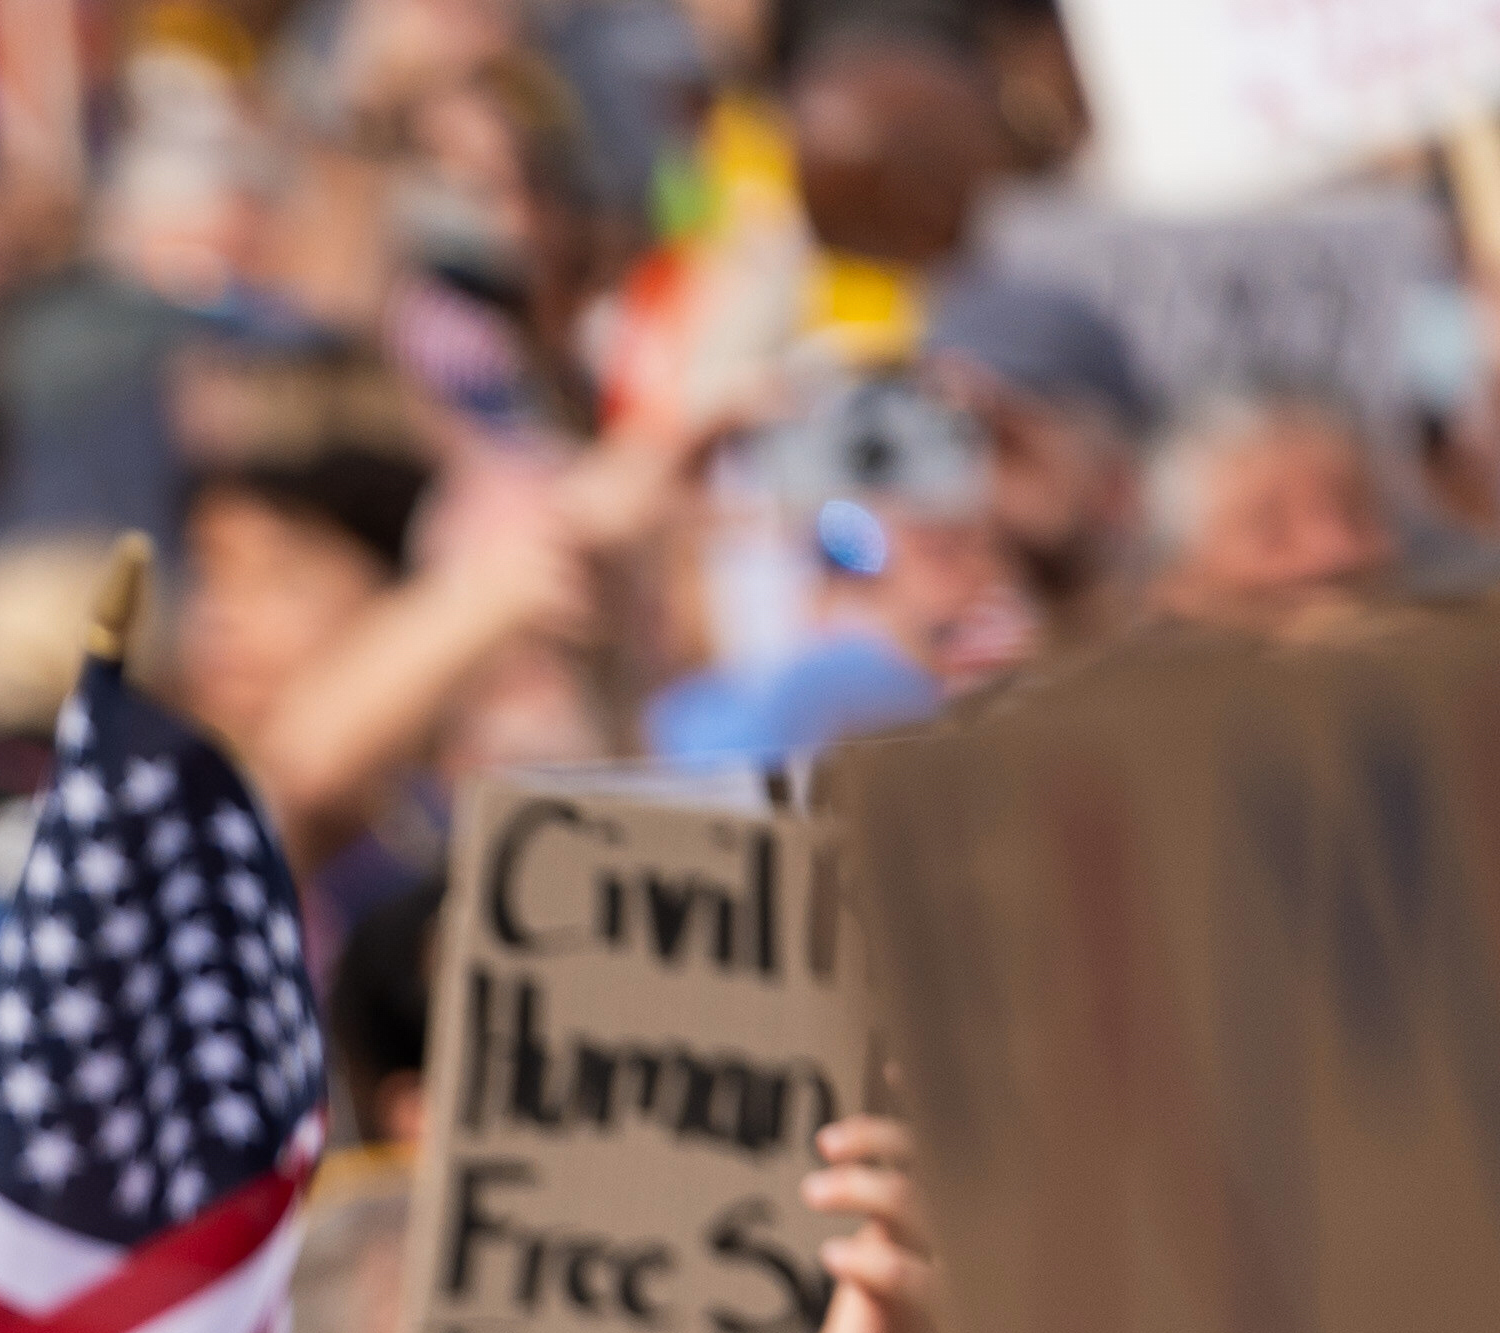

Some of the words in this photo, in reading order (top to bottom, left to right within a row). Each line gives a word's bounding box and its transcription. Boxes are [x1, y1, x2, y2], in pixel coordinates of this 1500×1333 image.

[481, 802, 783, 980] Civil
[465, 960, 838, 1158] Human
[444, 1158, 672, 1325] Free
